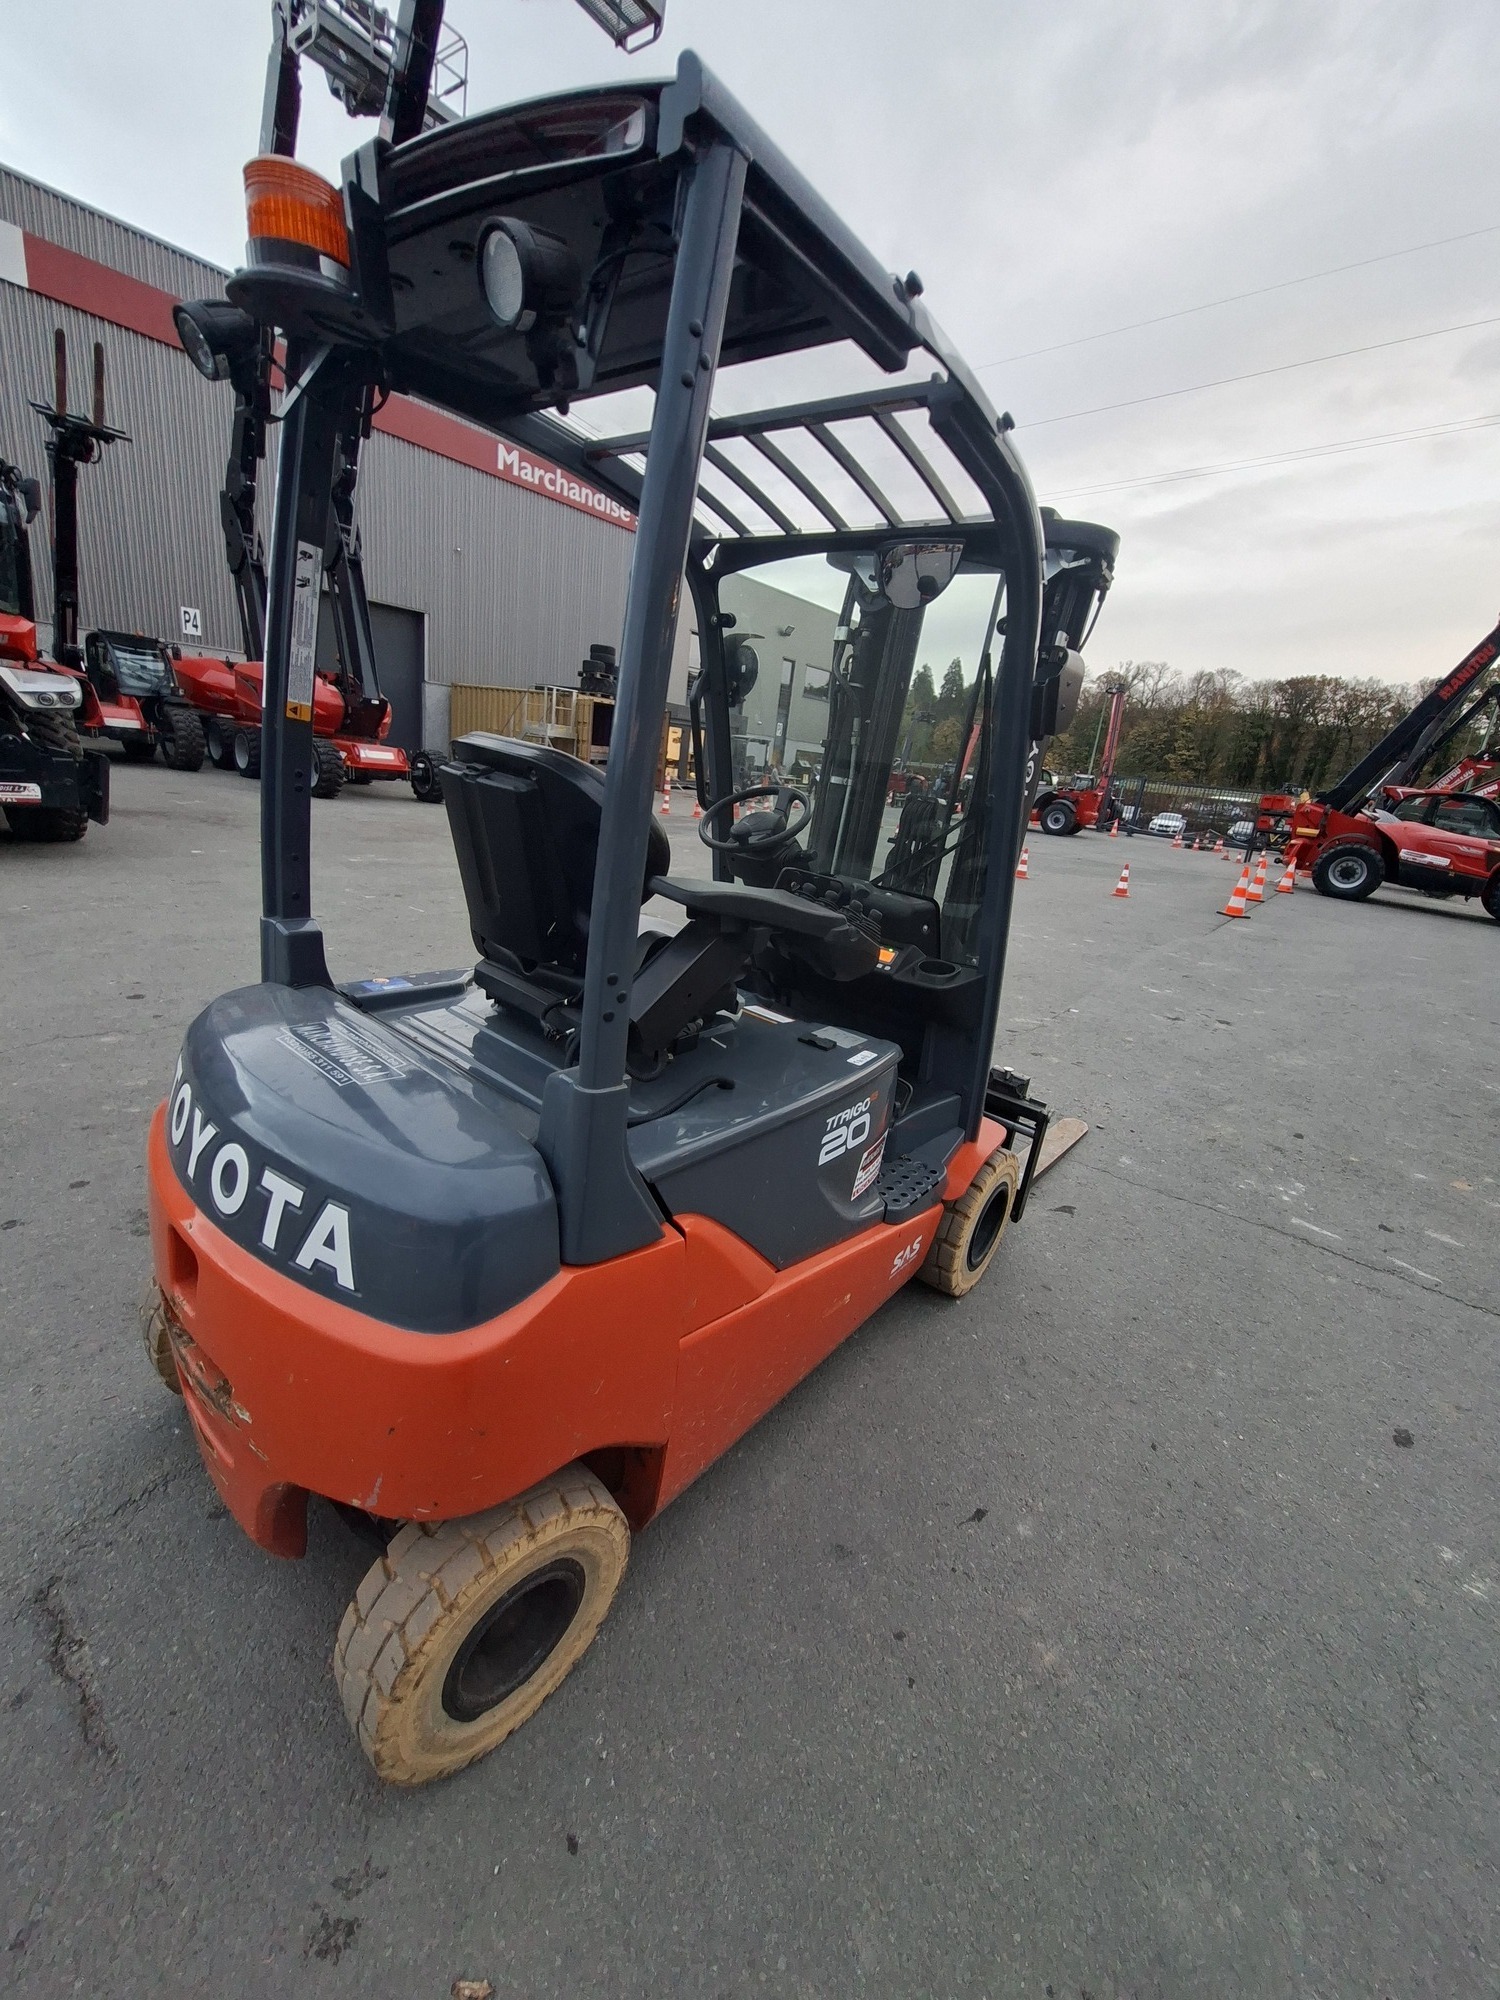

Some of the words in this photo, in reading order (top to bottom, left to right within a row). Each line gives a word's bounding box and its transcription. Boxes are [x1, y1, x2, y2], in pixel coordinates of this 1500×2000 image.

[497, 443, 631, 522] Marchandise
[183, 610, 199, 632] P4
[1438, 644, 1496, 700] MANITOU
[291, 1023, 375, 1066] MARCHANDISE
[314, 1057, 333, 1071] 311
[330, 1069, 350, 1083] 591
[818, 1112, 871, 1166] 20
[168, 1053, 355, 1291] TOYOTA
[890, 1234, 923, 1275] SAS
